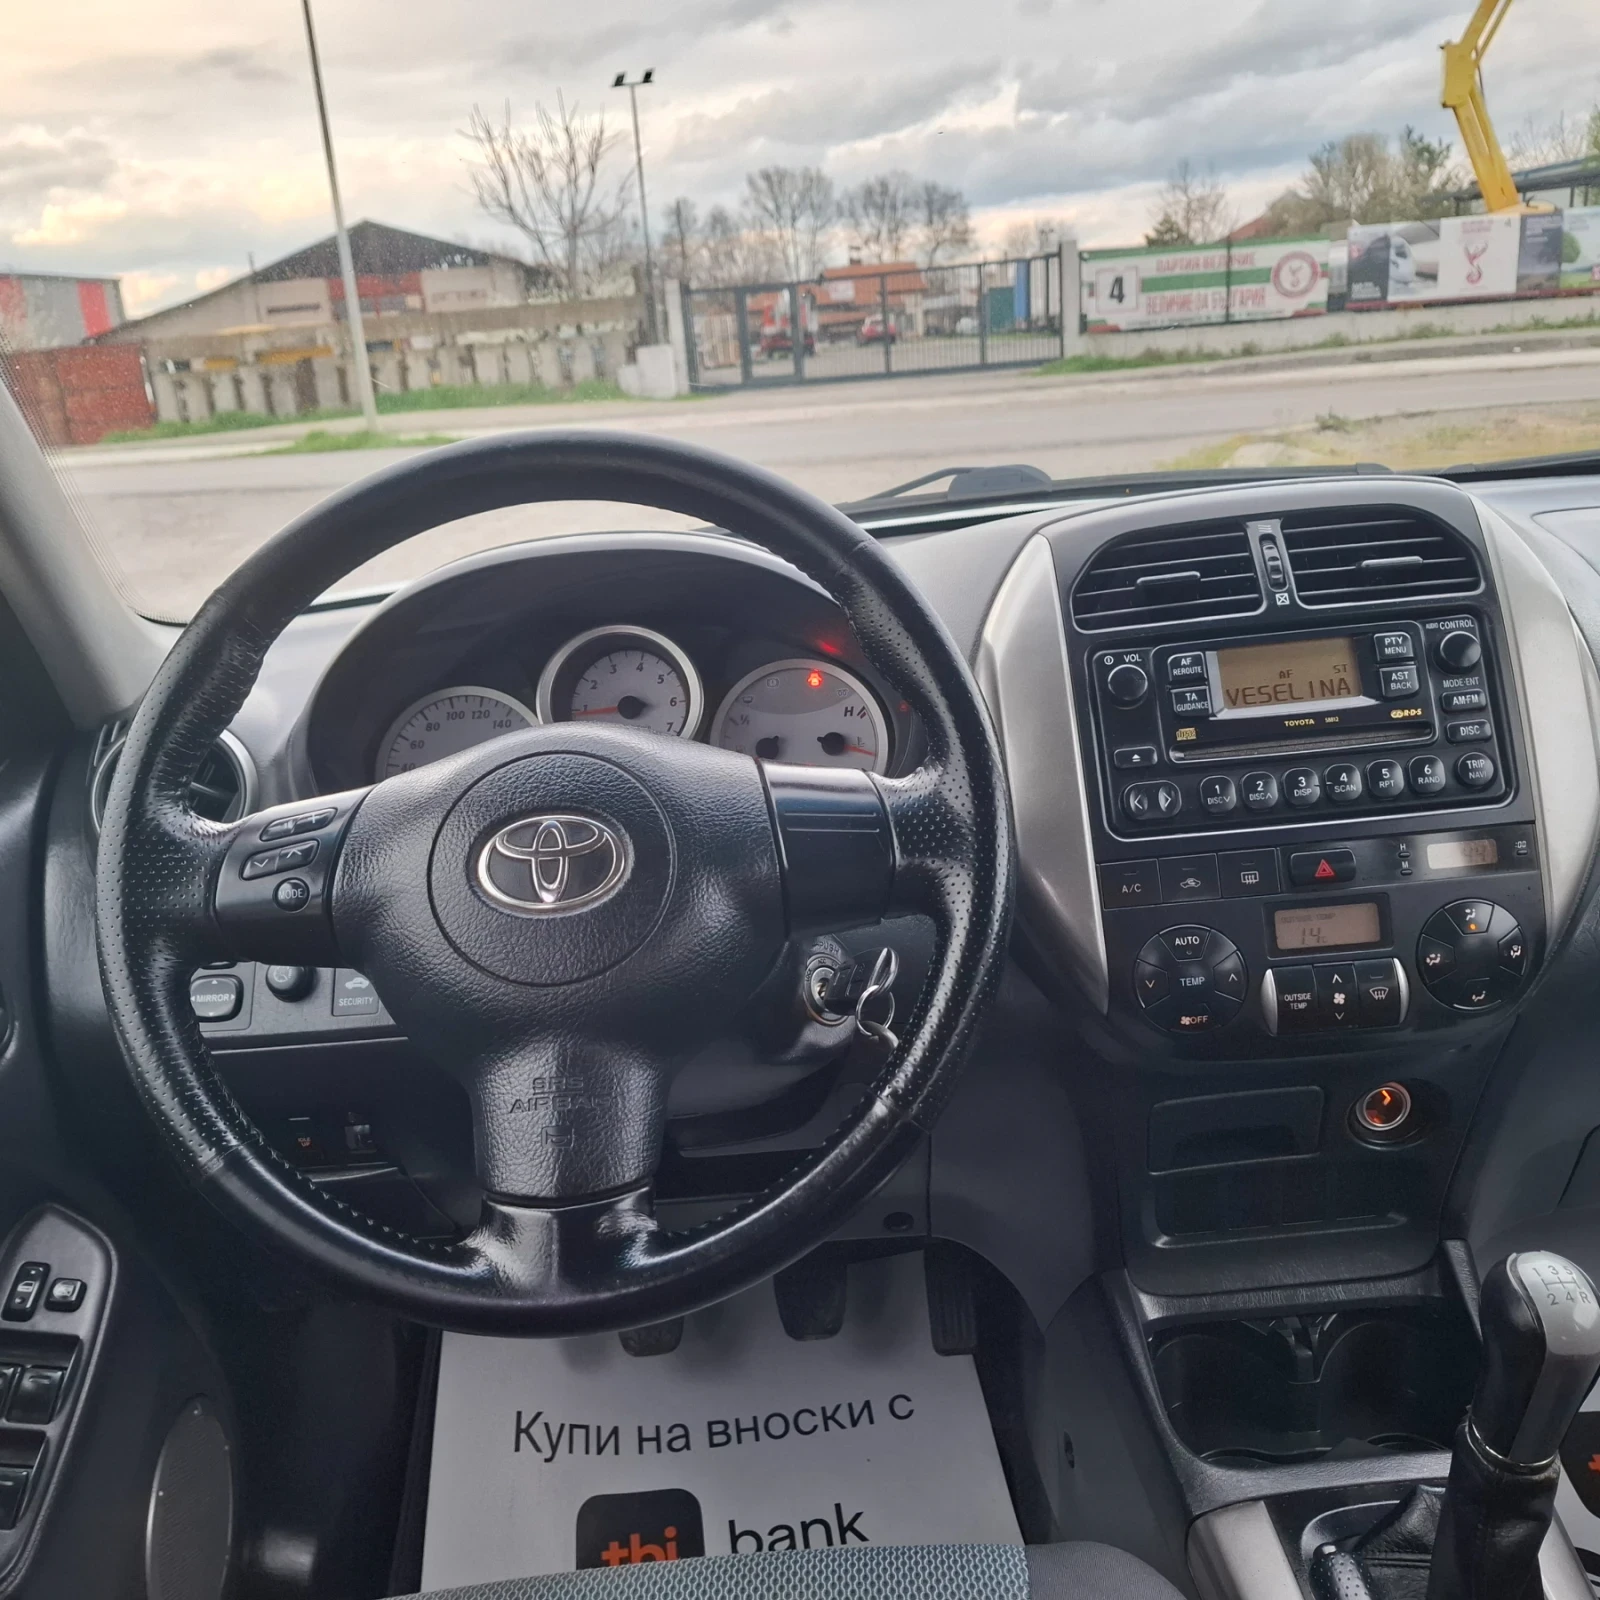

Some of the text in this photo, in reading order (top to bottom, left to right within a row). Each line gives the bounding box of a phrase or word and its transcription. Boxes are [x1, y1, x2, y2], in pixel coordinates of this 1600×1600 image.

[1109, 276, 1125, 303] 4
[1439, 619, 1475, 630] CONTROL
[1384, 636, 1403, 645] PTY
[1385, 646, 1407, 655] MENU
[1123, 653, 1142, 663] VOL
[1181, 657, 1192, 666] AF
[609, 662, 644, 674] 3 4
[1173, 666, 1202, 676] REROUTE
[1333, 663, 1348, 674] ST
[657, 674, 665, 684] 5
[1279, 669, 1293, 679] AF
[1391, 671, 1409, 681] AST
[590, 680, 598, 690] 2
[1390, 681, 1412, 690] BACK
[1185, 692, 1198, 701] TA
[1226, 677, 1351, 706] VESELINA
[670, 697, 677, 707] 6
[1176, 701, 1209, 712] GUIDANCE
[446, 710, 465, 720] 100
[471, 709, 490, 719] 120
[844, 706, 854, 717] H
[426, 722, 440, 731] 80
[492, 719, 511, 729] 140
[667, 722, 674, 732] 7
[1284, 718, 1315, 727] TOYOTA
[1460, 725, 1481, 736] DISC
[410, 740, 425, 749] 60
[1466, 759, 1485, 769] TRIP
[1382, 768, 1390, 779] 5
[1424, 764, 1432, 775] 6
[1469, 770, 1487, 779] NAVI
[1298, 776, 1306, 787] 3
[1340, 772, 1348, 782] 4
[1418, 775, 1441, 785] RAND
[1256, 781, 1264, 791] 2
[1334, 783, 1357, 793] SCAN
[1379, 780, 1395, 788] RPT
[1214, 785, 1220, 794] 1
[1294, 788, 1312, 797] DISP
[279, 887, 304, 899] MODE
[1122, 883, 1142, 893] A/C
[1175, 936, 1200, 946] AUTO
[1180, 976, 1205, 987] TEMP
[196, 993, 230, 1003] MIRROR
[339, 996, 374, 1007] SECURITY
[1284, 992, 1312, 1002] OUTSIDE
[1290, 1002, 1308, 1010] TEMP
[1191, 1015, 1209, 1025] OFF
[532, 1076, 584, 1092] SRS
[1532, 1265, 1573, 1277] 1 3 5
[1547, 1291, 1592, 1306] 2 4 R
[513, 1394, 915, 1463] Купи на вноски с
[728, 1502, 870, 1555] bank
